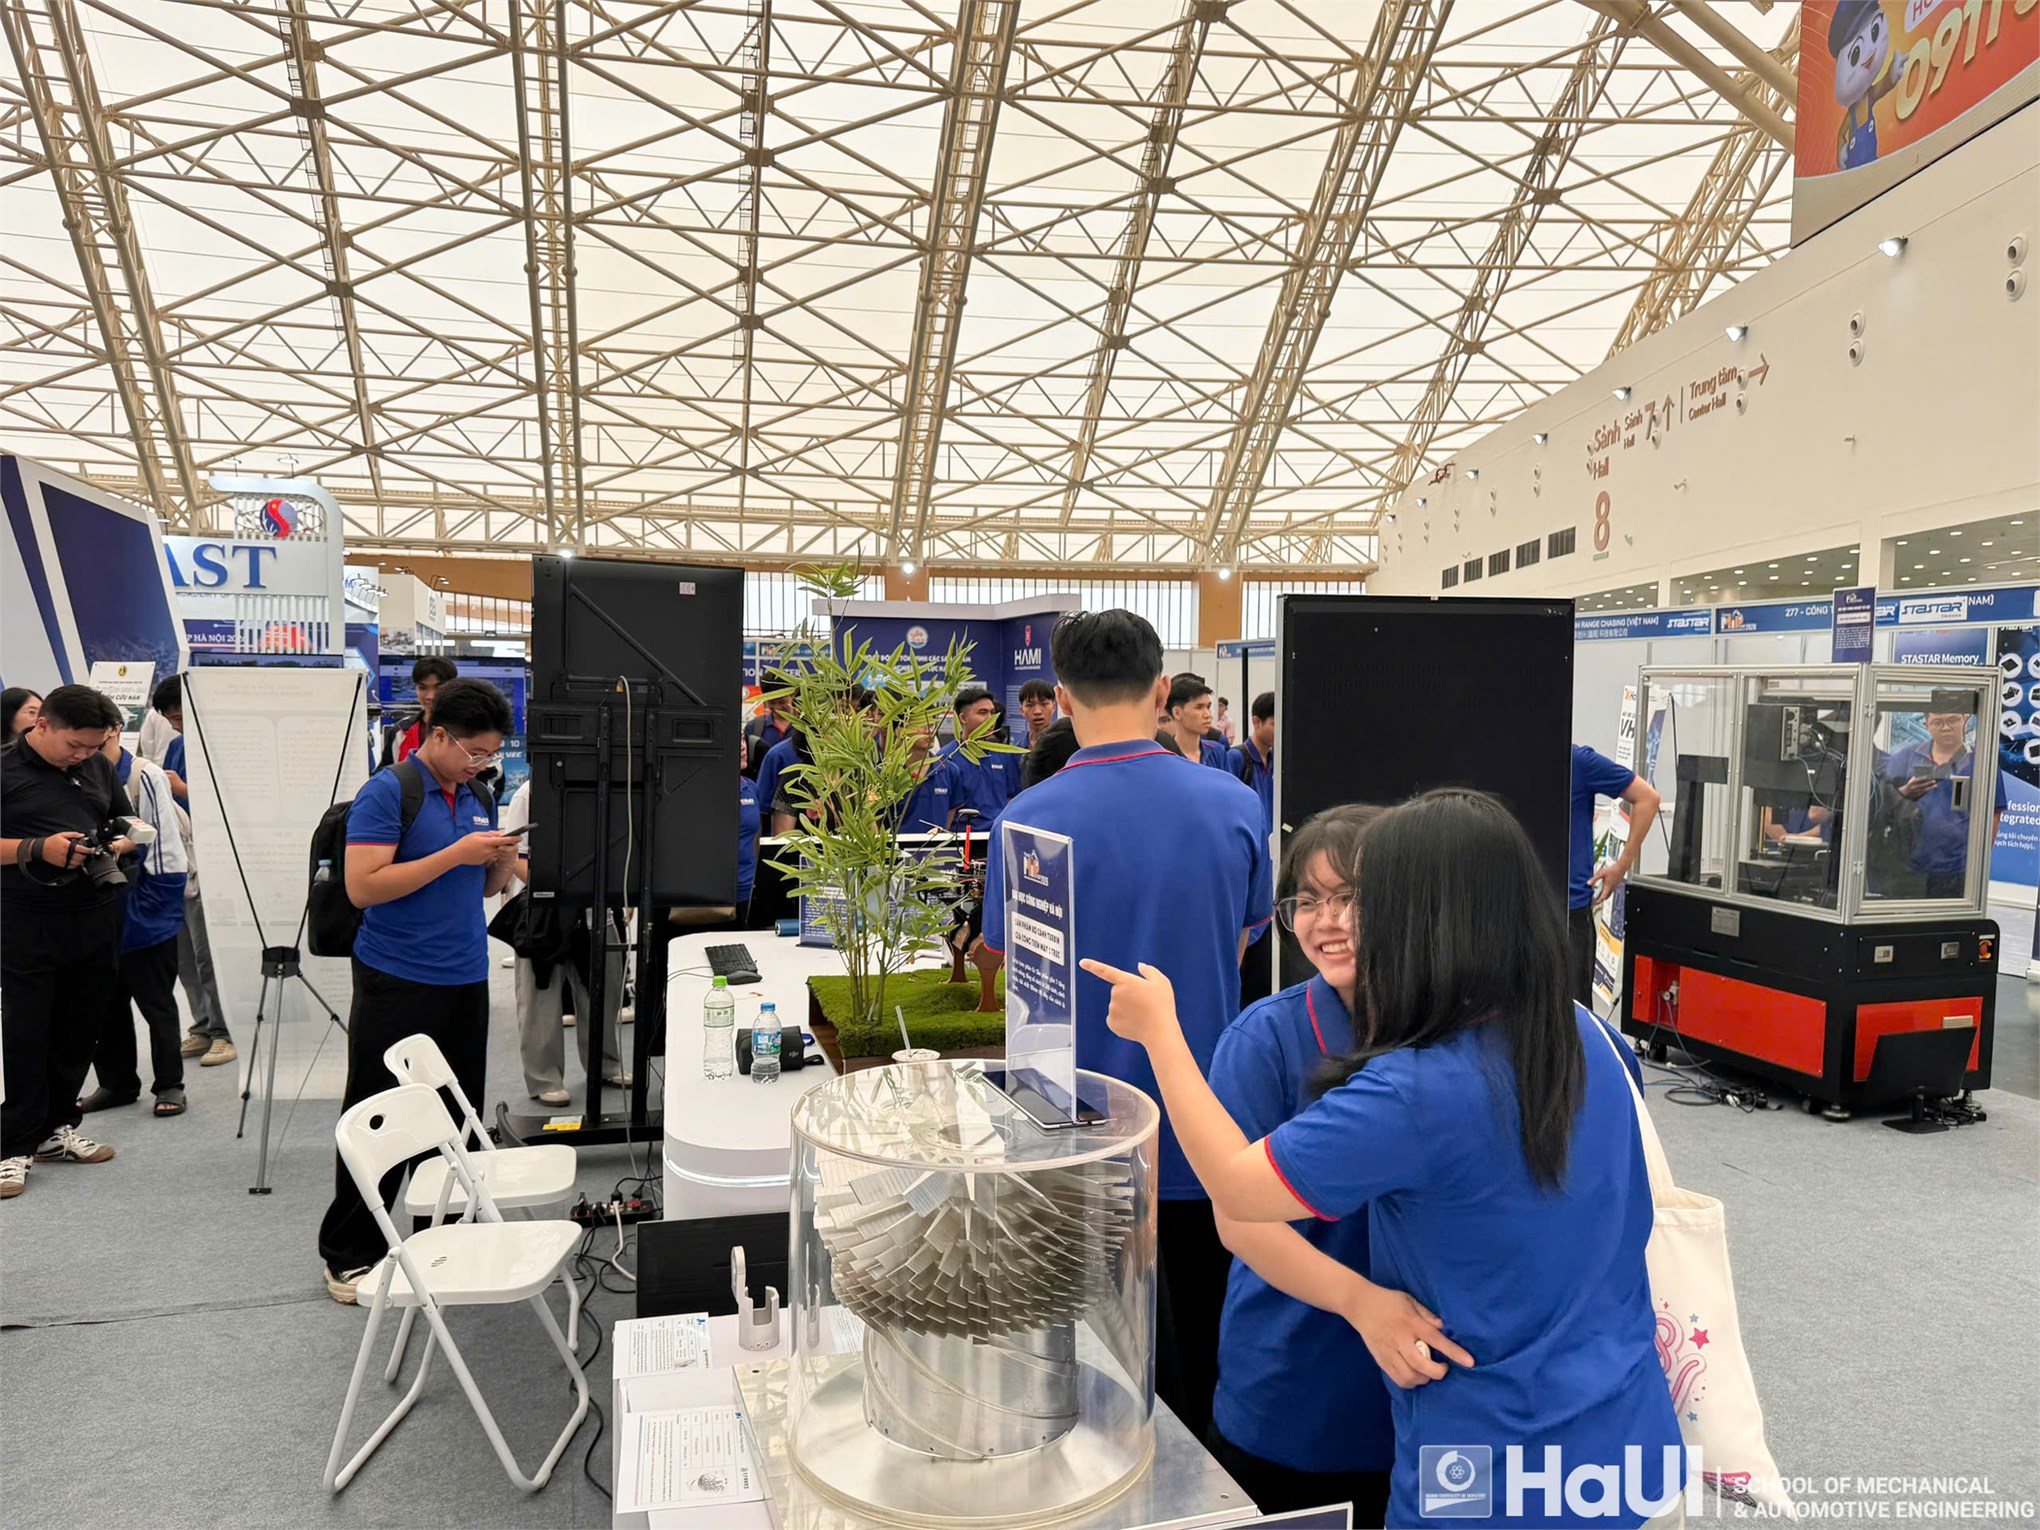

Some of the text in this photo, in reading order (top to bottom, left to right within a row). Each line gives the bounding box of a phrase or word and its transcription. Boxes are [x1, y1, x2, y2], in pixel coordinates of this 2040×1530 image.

[1689, 366, 1738, 400] Trung tâm
[1689, 392, 1726, 420] Center Hall
[1645, 400, 1657, 440] 7
[1624, 434, 1635, 449] Hall
[1593, 457, 1609, 480] Hall
[1594, 491, 1610, 551] 8
[1785, 608, 1799, 617] 277
[1805, 605, 1828, 616] CÔNG
[194, 633, 207, 642] HÀ
[208, 633, 225, 643] NỘI
[1014, 648, 1042, 665] HAMI
[1901, 653, 1979, 665] STASTAR Memory
